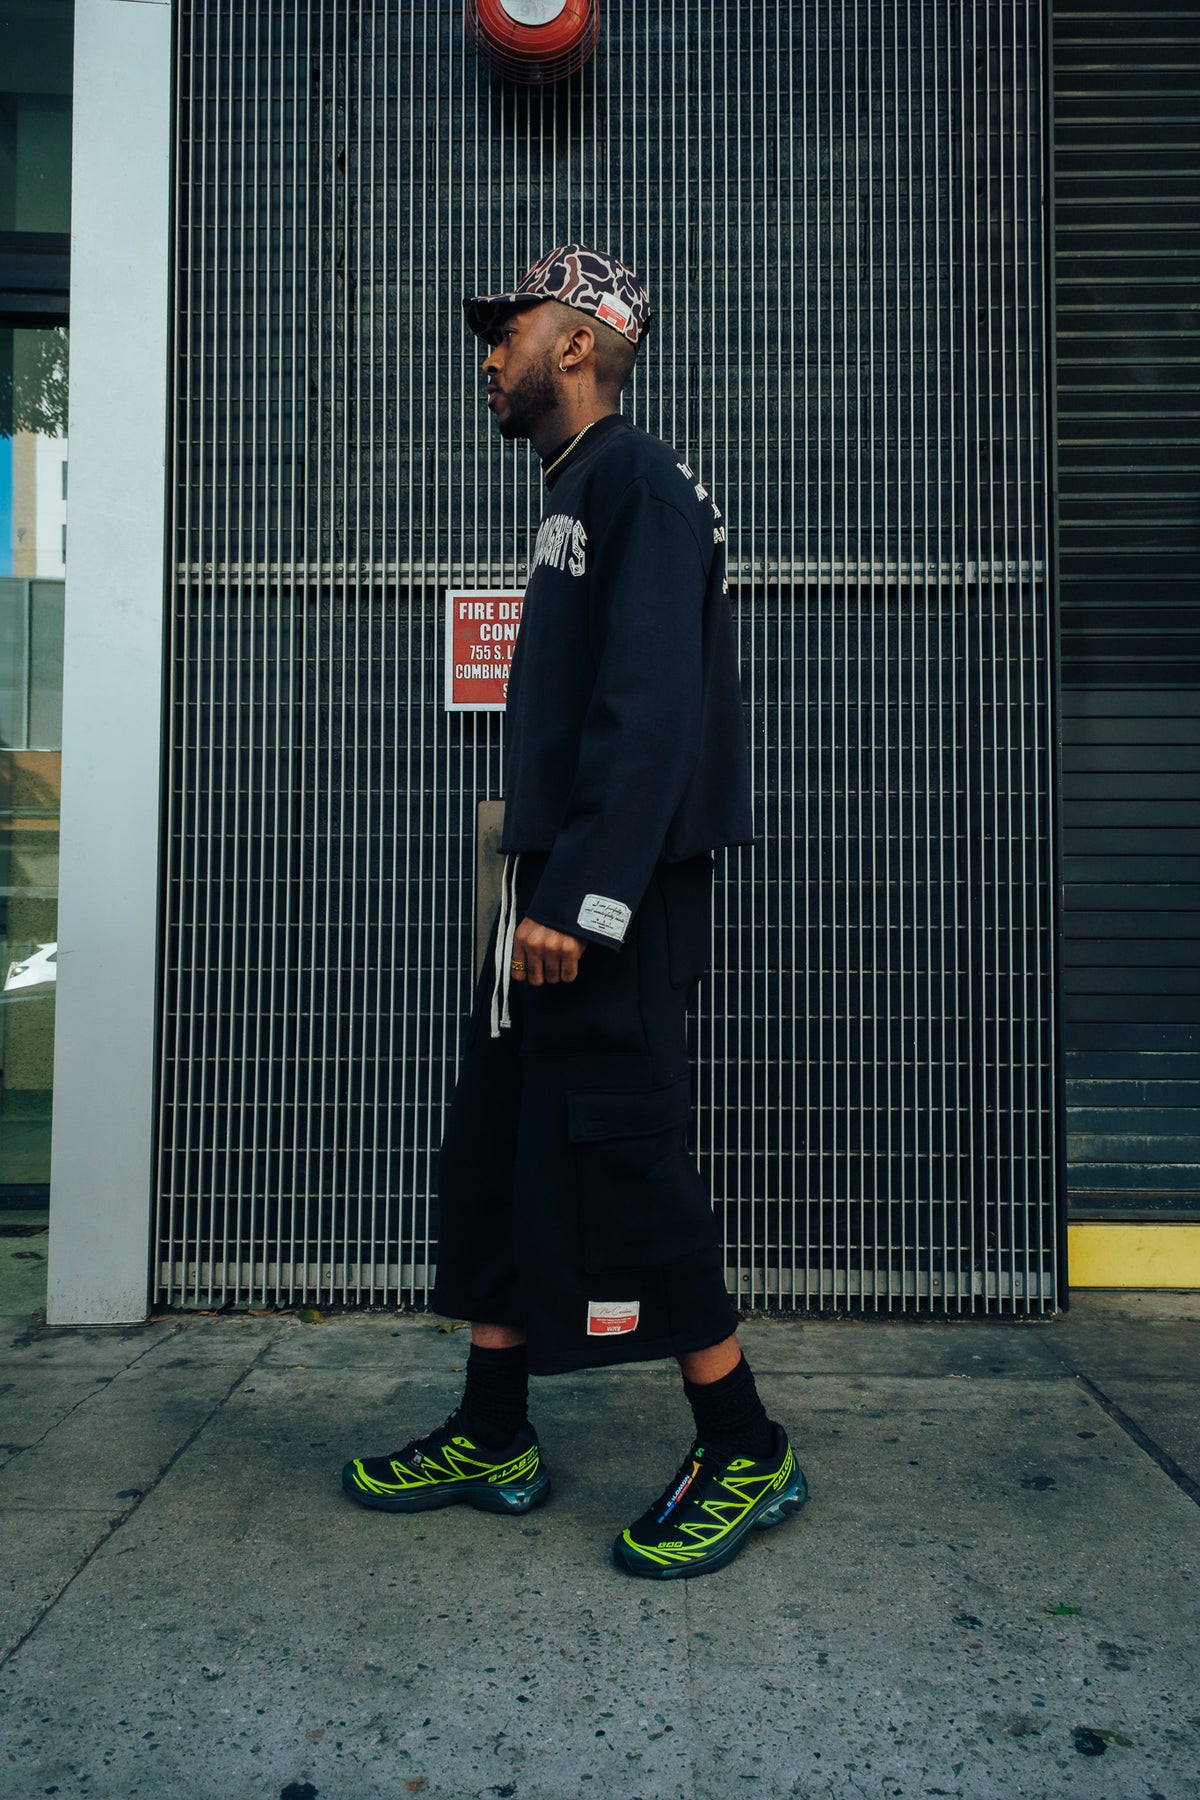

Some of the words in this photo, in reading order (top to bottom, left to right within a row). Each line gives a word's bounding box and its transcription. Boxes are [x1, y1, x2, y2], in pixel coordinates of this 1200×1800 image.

[459, 602, 495, 620] FIRE
[469, 645, 491, 661] 755
[494, 645, 504, 660] S.
[507, 645, 516, 660] L
[455, 664, 511, 679] COMBINA
